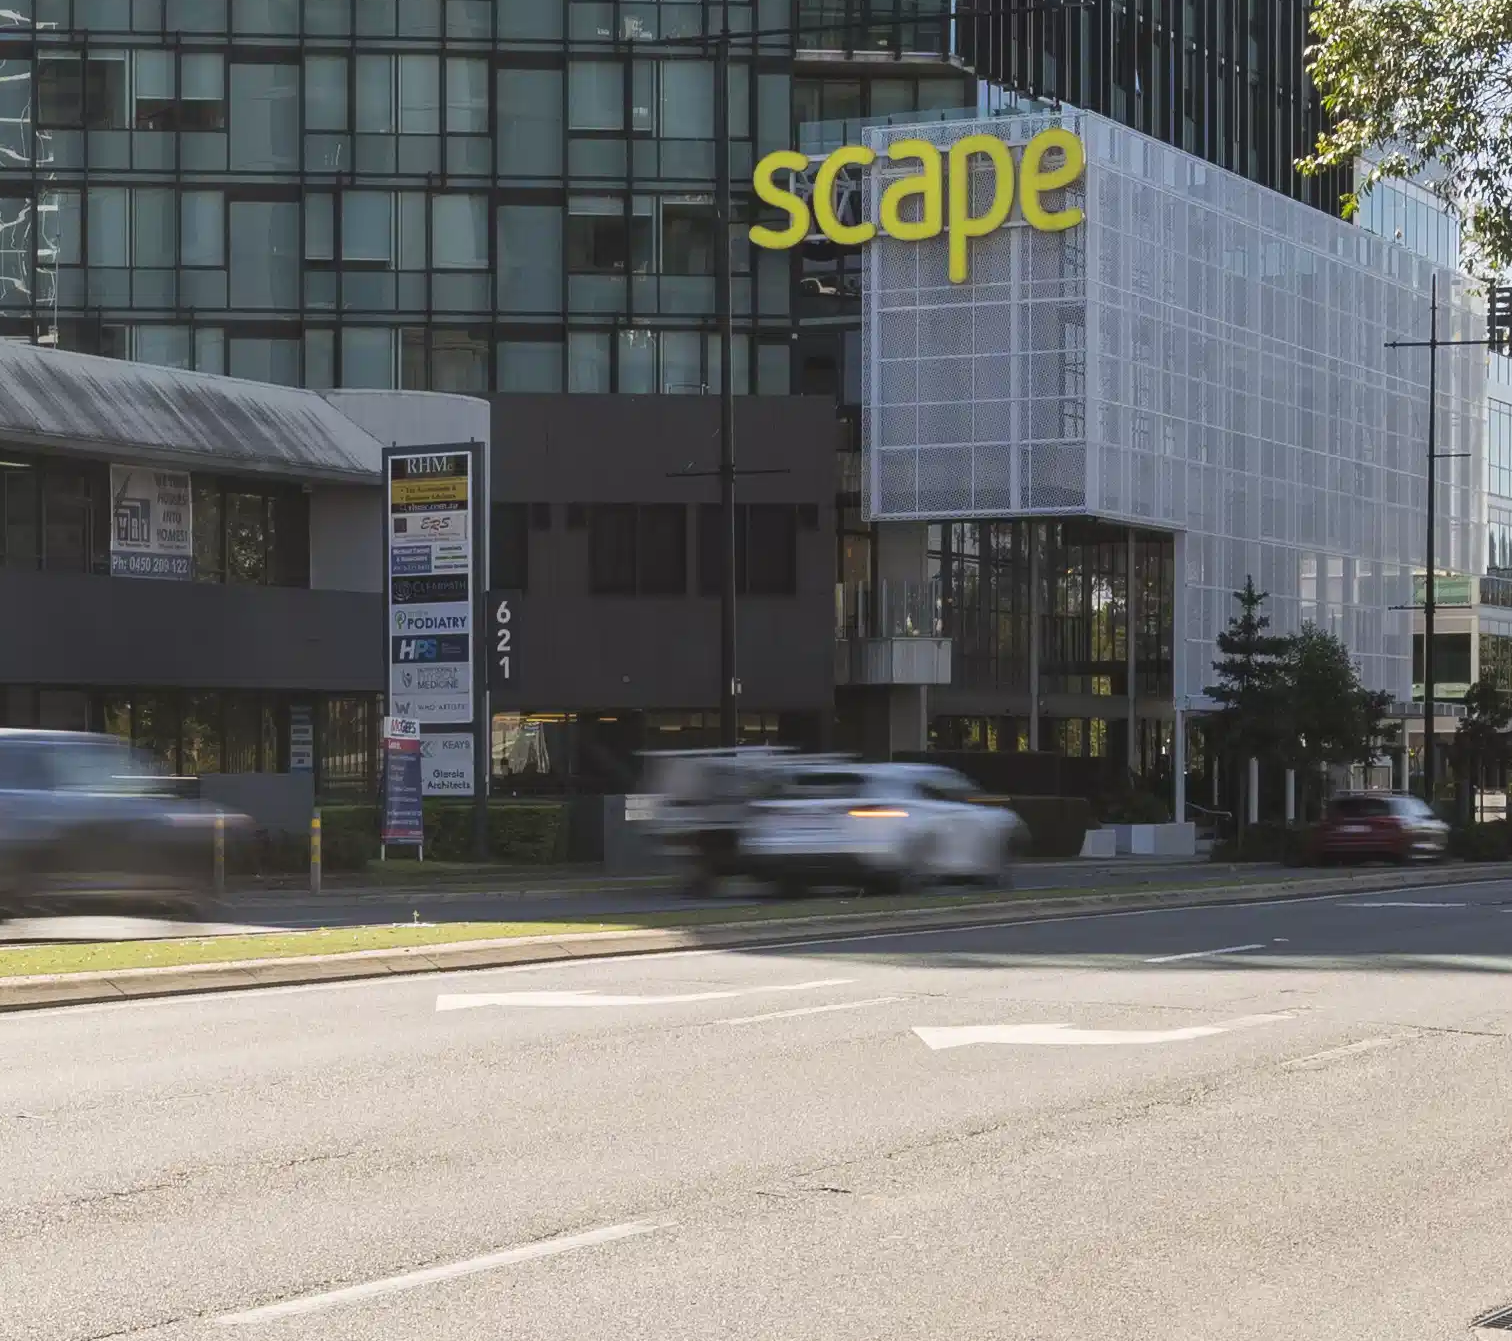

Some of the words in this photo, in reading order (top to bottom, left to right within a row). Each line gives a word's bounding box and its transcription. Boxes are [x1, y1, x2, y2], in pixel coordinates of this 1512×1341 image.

[748, 127, 1086, 284] scape
[112, 556, 127, 570] Ph:
[129, 557, 150, 572] 0450
[172, 559, 188, 574] 122
[407, 615, 467, 630] PODIATRY
[399, 638, 437, 660] HPS
[417, 679, 459, 690] MEDICINE
